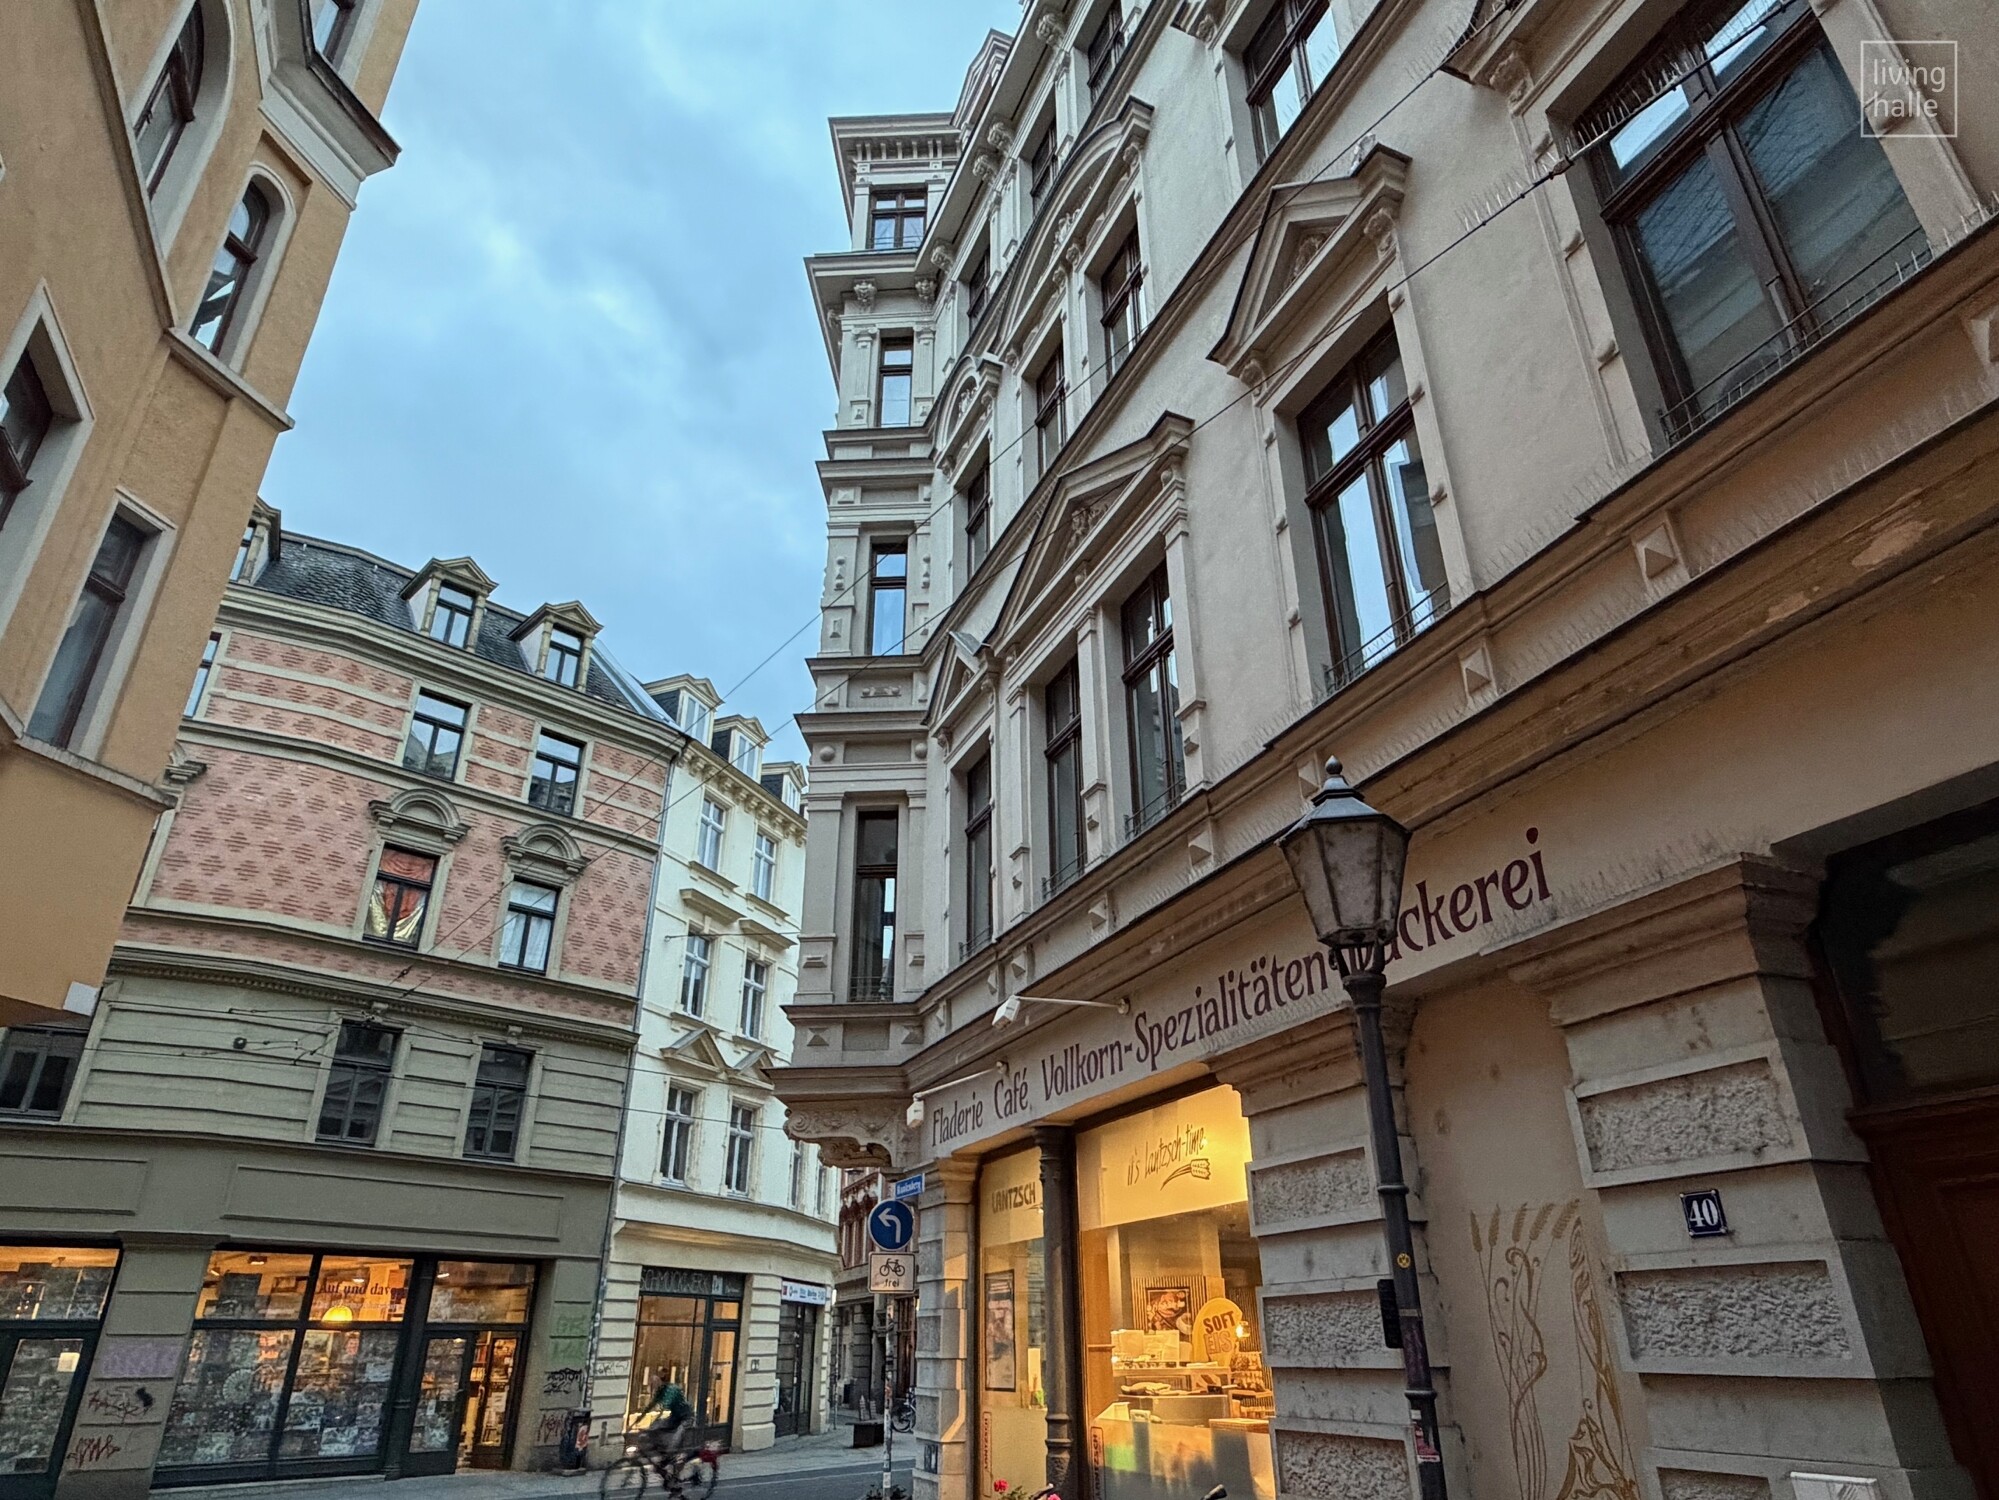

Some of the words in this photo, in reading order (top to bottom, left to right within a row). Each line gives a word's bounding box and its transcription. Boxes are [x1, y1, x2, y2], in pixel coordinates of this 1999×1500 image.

[931, 1091, 983, 1147] Fladerie
[994, 1067, 1029, 1119] Café
[1127, 1146, 1140, 1186] it's
[991, 1181, 1036, 1214] LANTZSCH
[1689, 1198, 1719, 1227] 40
[883, 1278, 900, 1288] frei
[1203, 1310, 1236, 1335] SOFT
[1203, 1330, 1233, 1355] EIS
